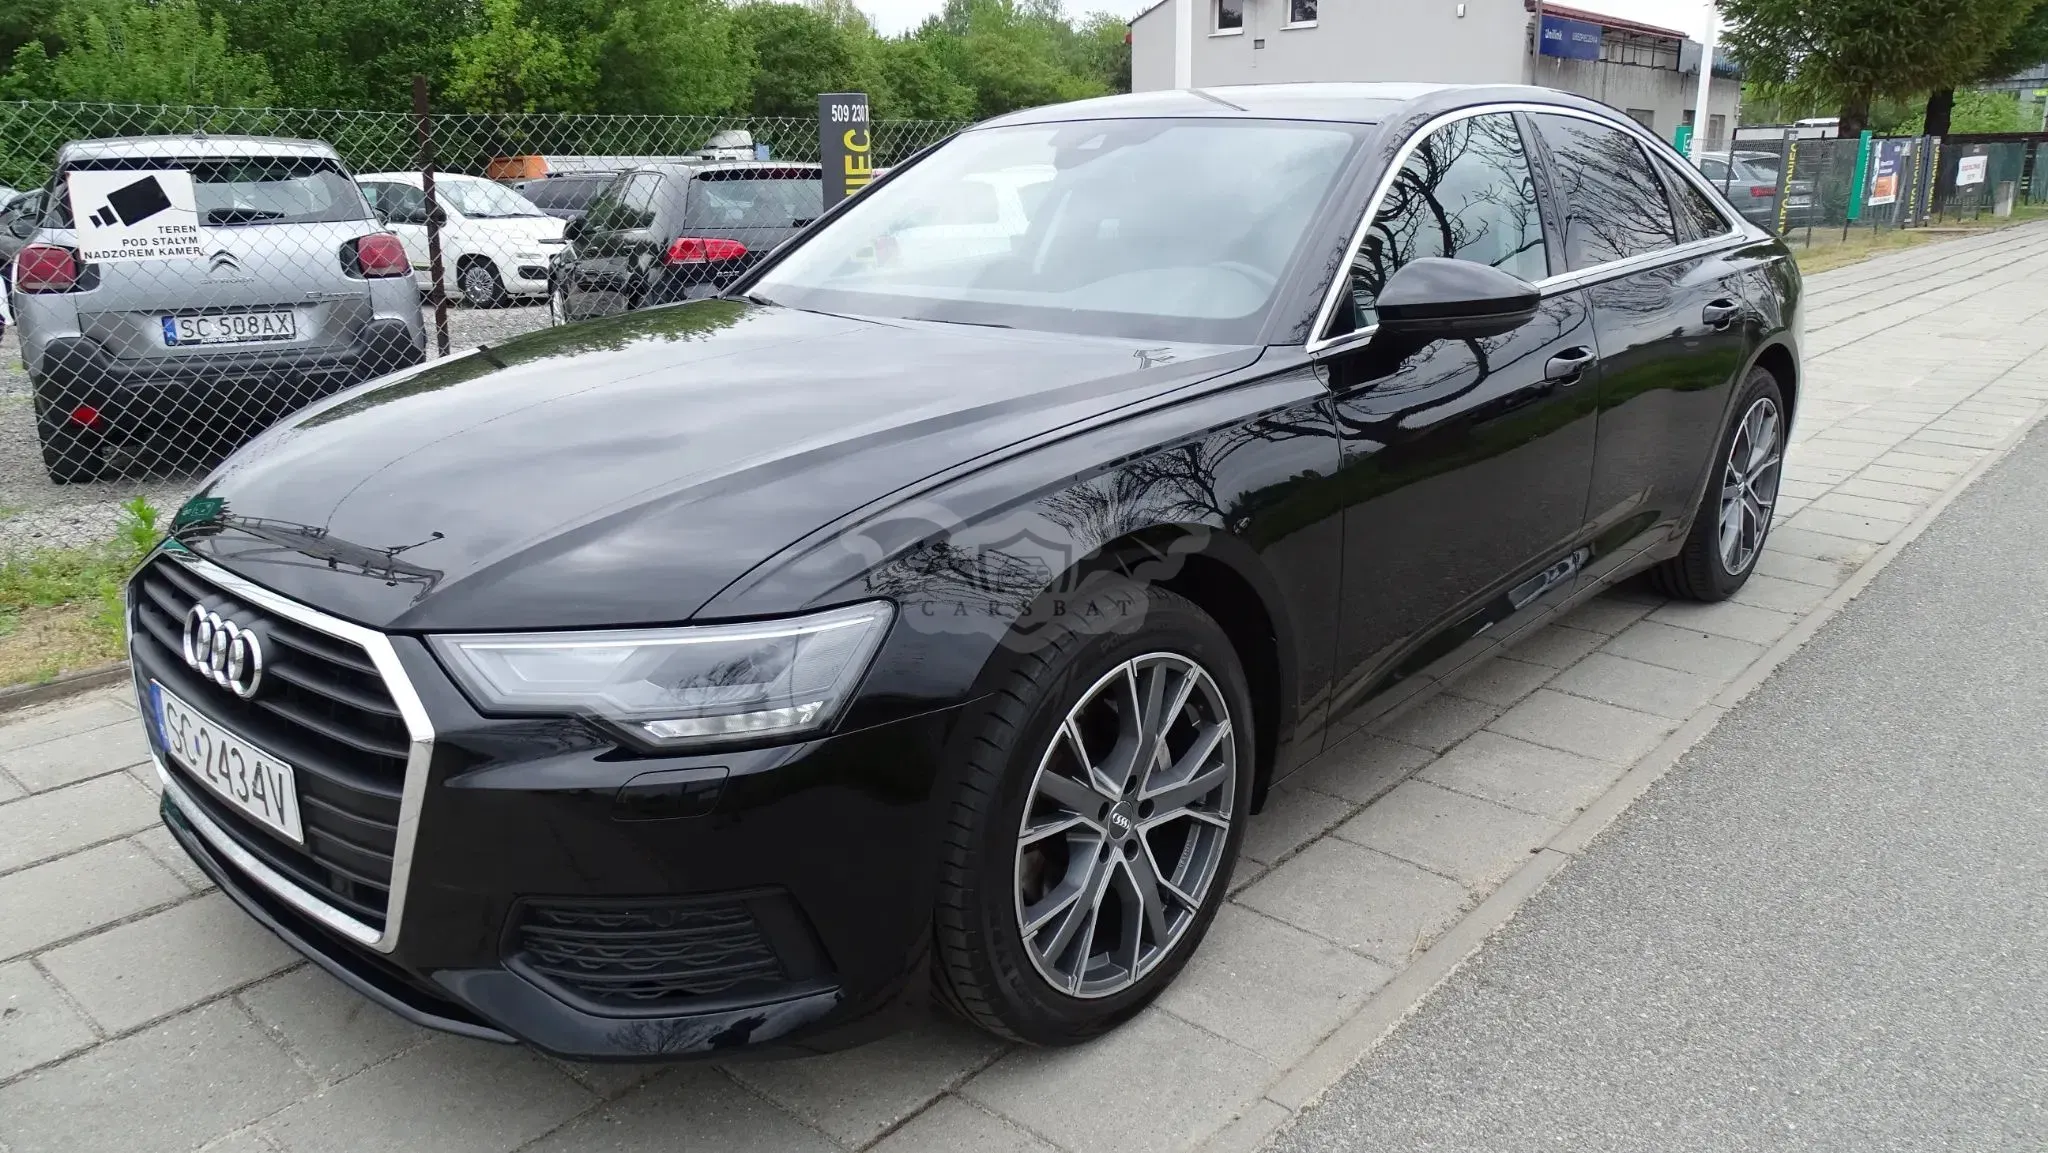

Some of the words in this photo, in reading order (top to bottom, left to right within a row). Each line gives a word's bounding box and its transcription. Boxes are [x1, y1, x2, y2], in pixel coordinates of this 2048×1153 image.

[831, 104, 849, 122] 509
[158, 225, 197, 234] TEREN
[122, 238, 148, 247] POD
[152, 236, 198, 246] STAŁYM
[84, 248, 155, 260] NADZOREM
[180, 318, 211, 339] SC
[220, 313, 290, 336] 508AX
[167, 701, 197, 766] SC
